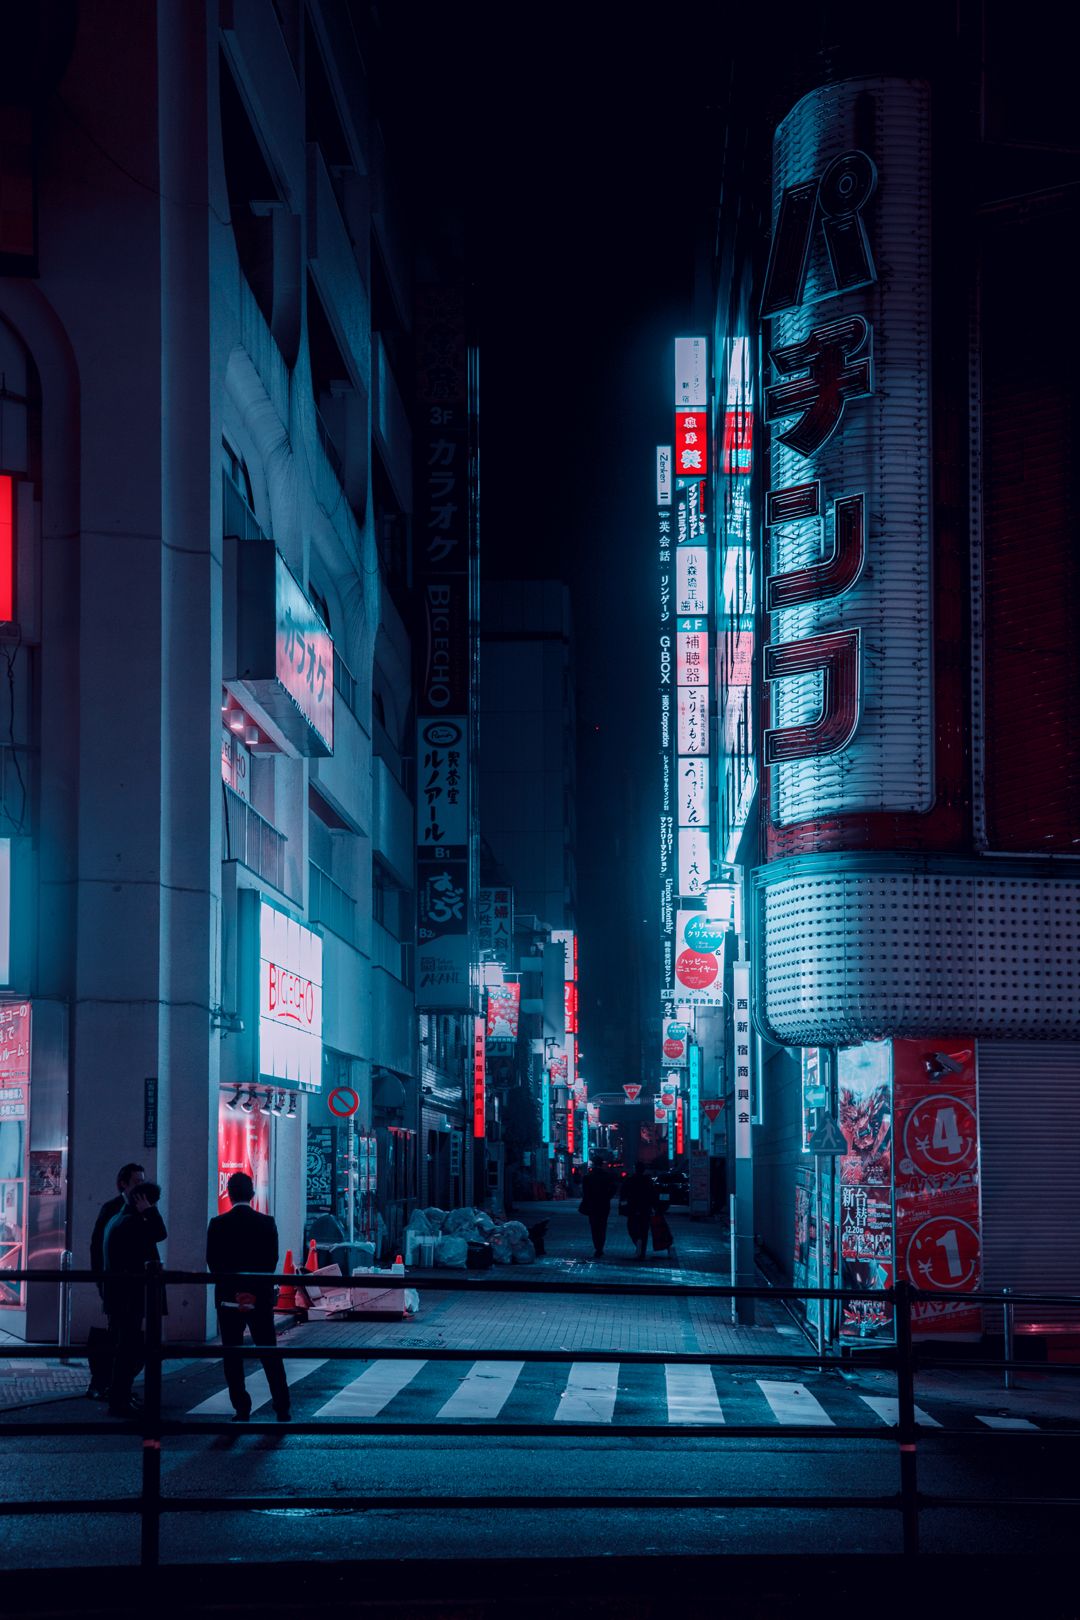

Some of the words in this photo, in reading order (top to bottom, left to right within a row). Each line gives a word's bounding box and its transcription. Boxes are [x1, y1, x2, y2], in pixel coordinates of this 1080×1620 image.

[429, 406, 453, 425] 3F
[761, 150, 886, 767] パチンコ
[426, 438, 459, 563] カラオケ
[688, 484, 698, 538] インターネット
[659, 521, 671, 562] 英会話
[660, 575, 670, 622] リンゲージ
[682, 619, 703, 631] 4F
[284, 606, 328, 704] カラオケ
[660, 636, 671, 685] G-BOX
[686, 635, 701, 683] 補聴器
[662, 695, 670, 711] HIRO
[688, 690, 700, 752] とりえもん
[661, 711, 670, 748] Corporation
[423, 749, 446, 841] ルノアール
[447, 751, 461, 805] 喫茶室
[428, 871, 466, 923] すごろく
[664, 902, 674, 935] Monthly
[687, 931, 723, 940] クリスマス
[677, 965, 718, 974] ニューイヤー
[681, 958, 708, 966] ハッピー
[737, 998, 750, 1124] 西新宿商興会
